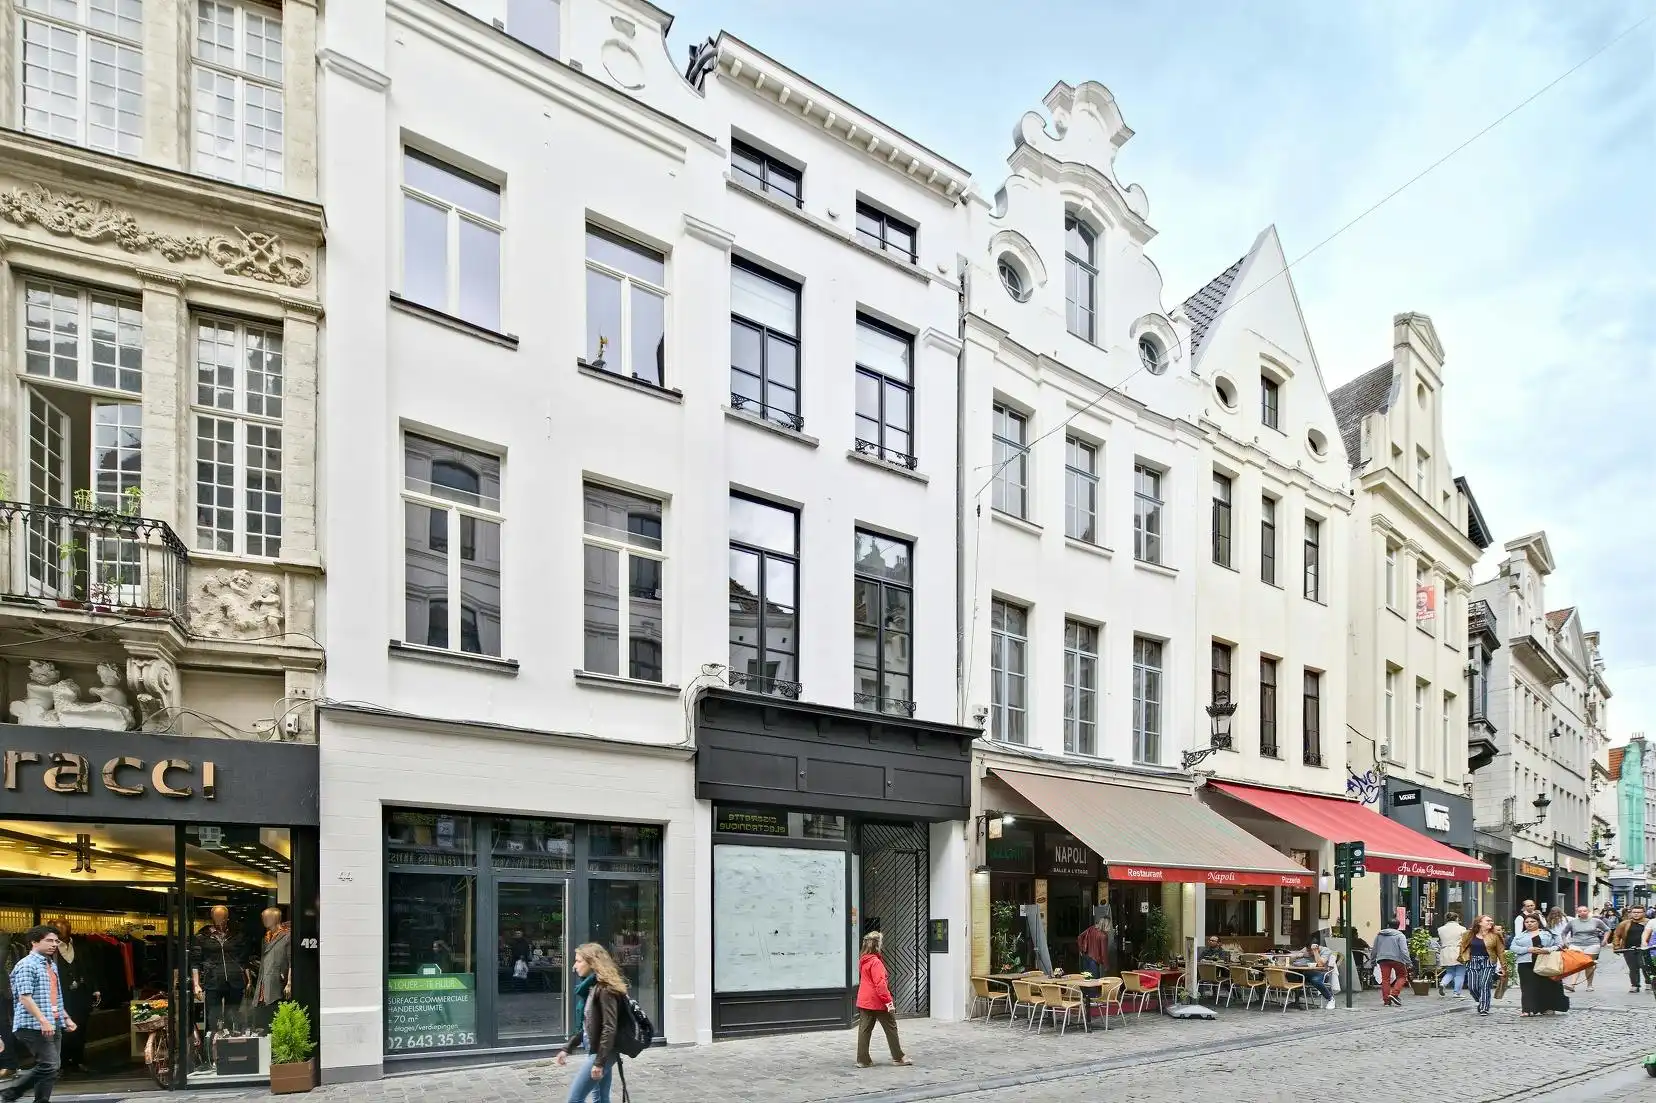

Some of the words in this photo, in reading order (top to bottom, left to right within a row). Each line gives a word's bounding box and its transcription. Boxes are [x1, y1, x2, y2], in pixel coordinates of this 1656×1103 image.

[1055, 846, 1087, 864] NAPOLI
[1397, 861, 1411, 873] Au
[1412, 864, 1425, 874] Coin
[1127, 868, 1163, 878] Restaurant
[1207, 871, 1235, 883] Napoli
[1281, 875, 1301, 884] Pizzeria
[301, 938, 318, 949] 42
[420, 995, 469, 1003] COMMERCIALE
[388, 1004, 443, 1013] HANDELSRUIMTE
[394, 1015, 406, 1024] 70
[407, 1035, 433, 1048] 643
[437, 1034, 454, 1046] 35
[458, 1033, 474, 1045] 35
